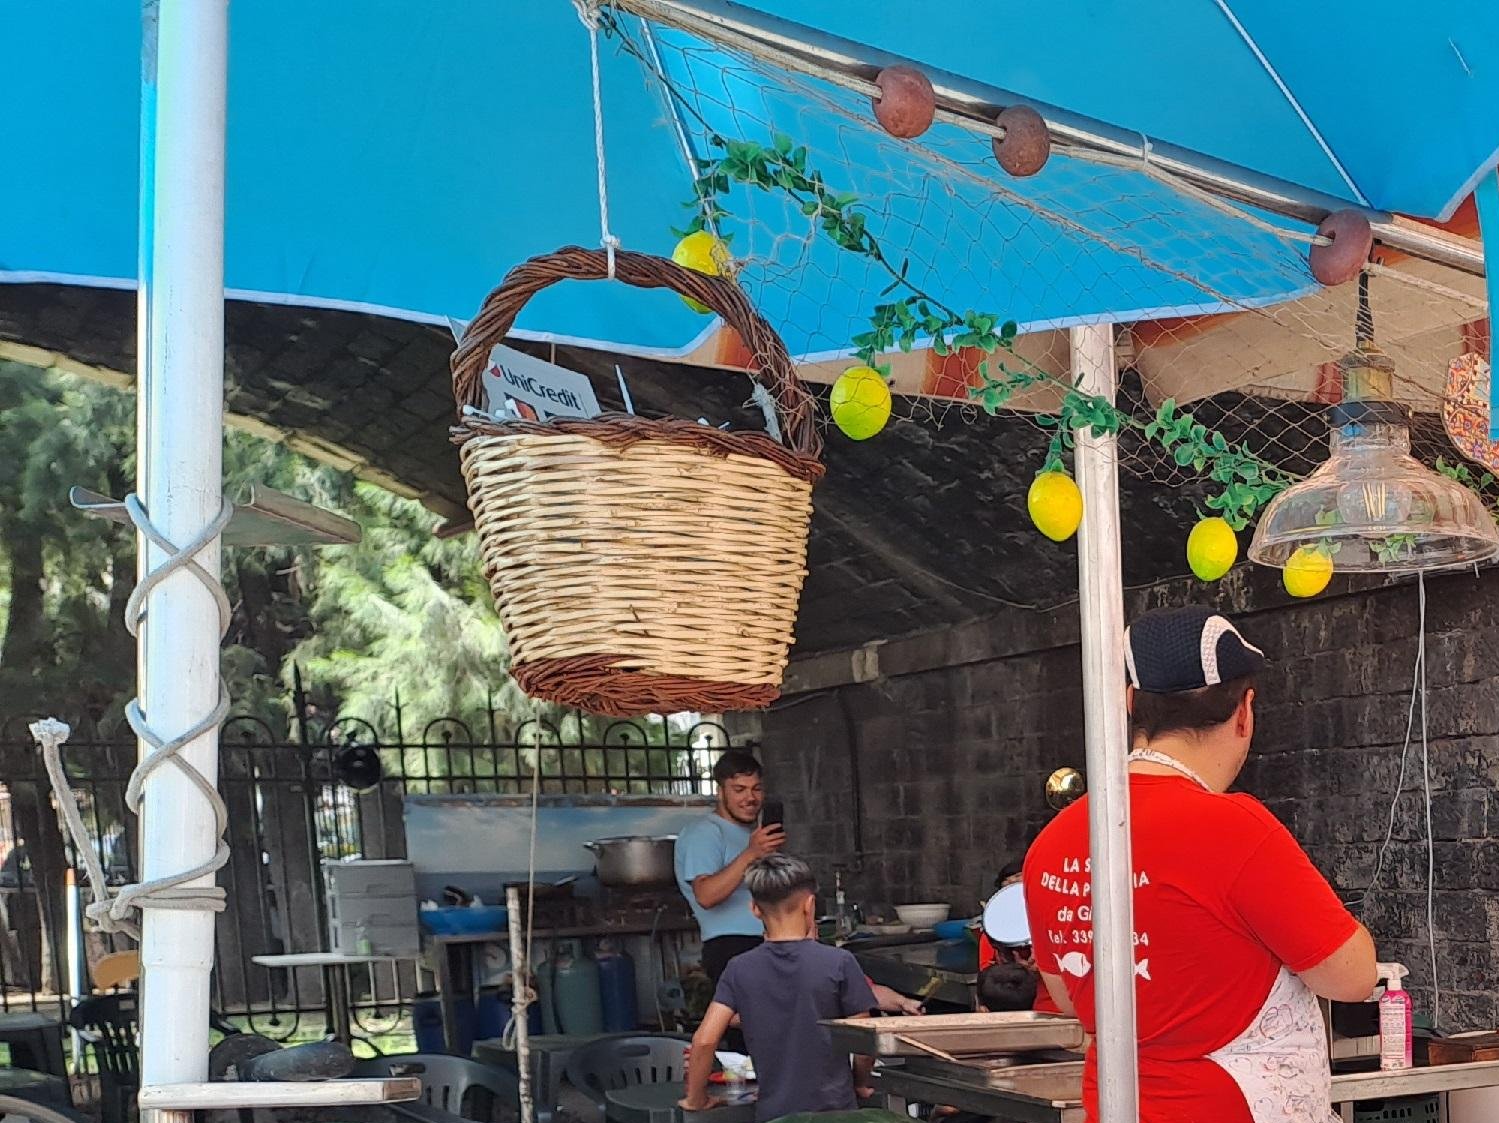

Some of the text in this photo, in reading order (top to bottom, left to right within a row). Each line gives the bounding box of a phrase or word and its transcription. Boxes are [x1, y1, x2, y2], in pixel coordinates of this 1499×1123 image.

[500, 364, 581, 411] UniCredit
[1063, 857, 1080, 873] LA
[1041, 871, 1080, 897] DELLA
[1057, 905, 1073, 922] da
